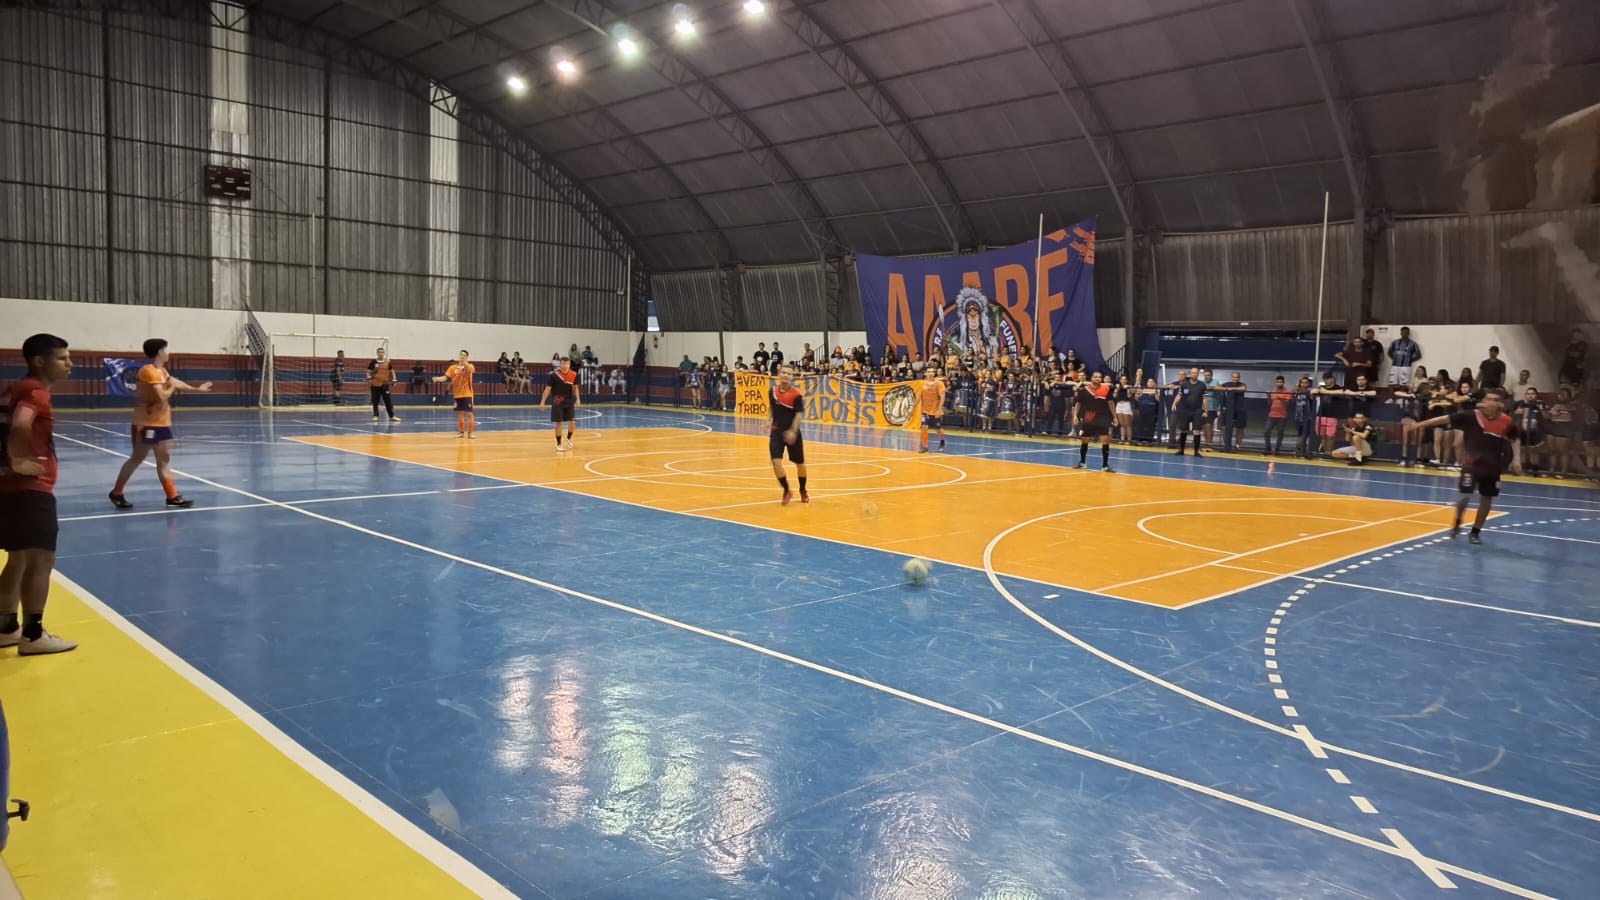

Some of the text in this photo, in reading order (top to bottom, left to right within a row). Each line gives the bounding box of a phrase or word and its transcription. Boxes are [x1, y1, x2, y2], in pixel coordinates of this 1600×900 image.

[736, 375, 766, 388] #VEM
[744, 390, 763, 401] PRA
[738, 401, 767, 415] TRIBO
